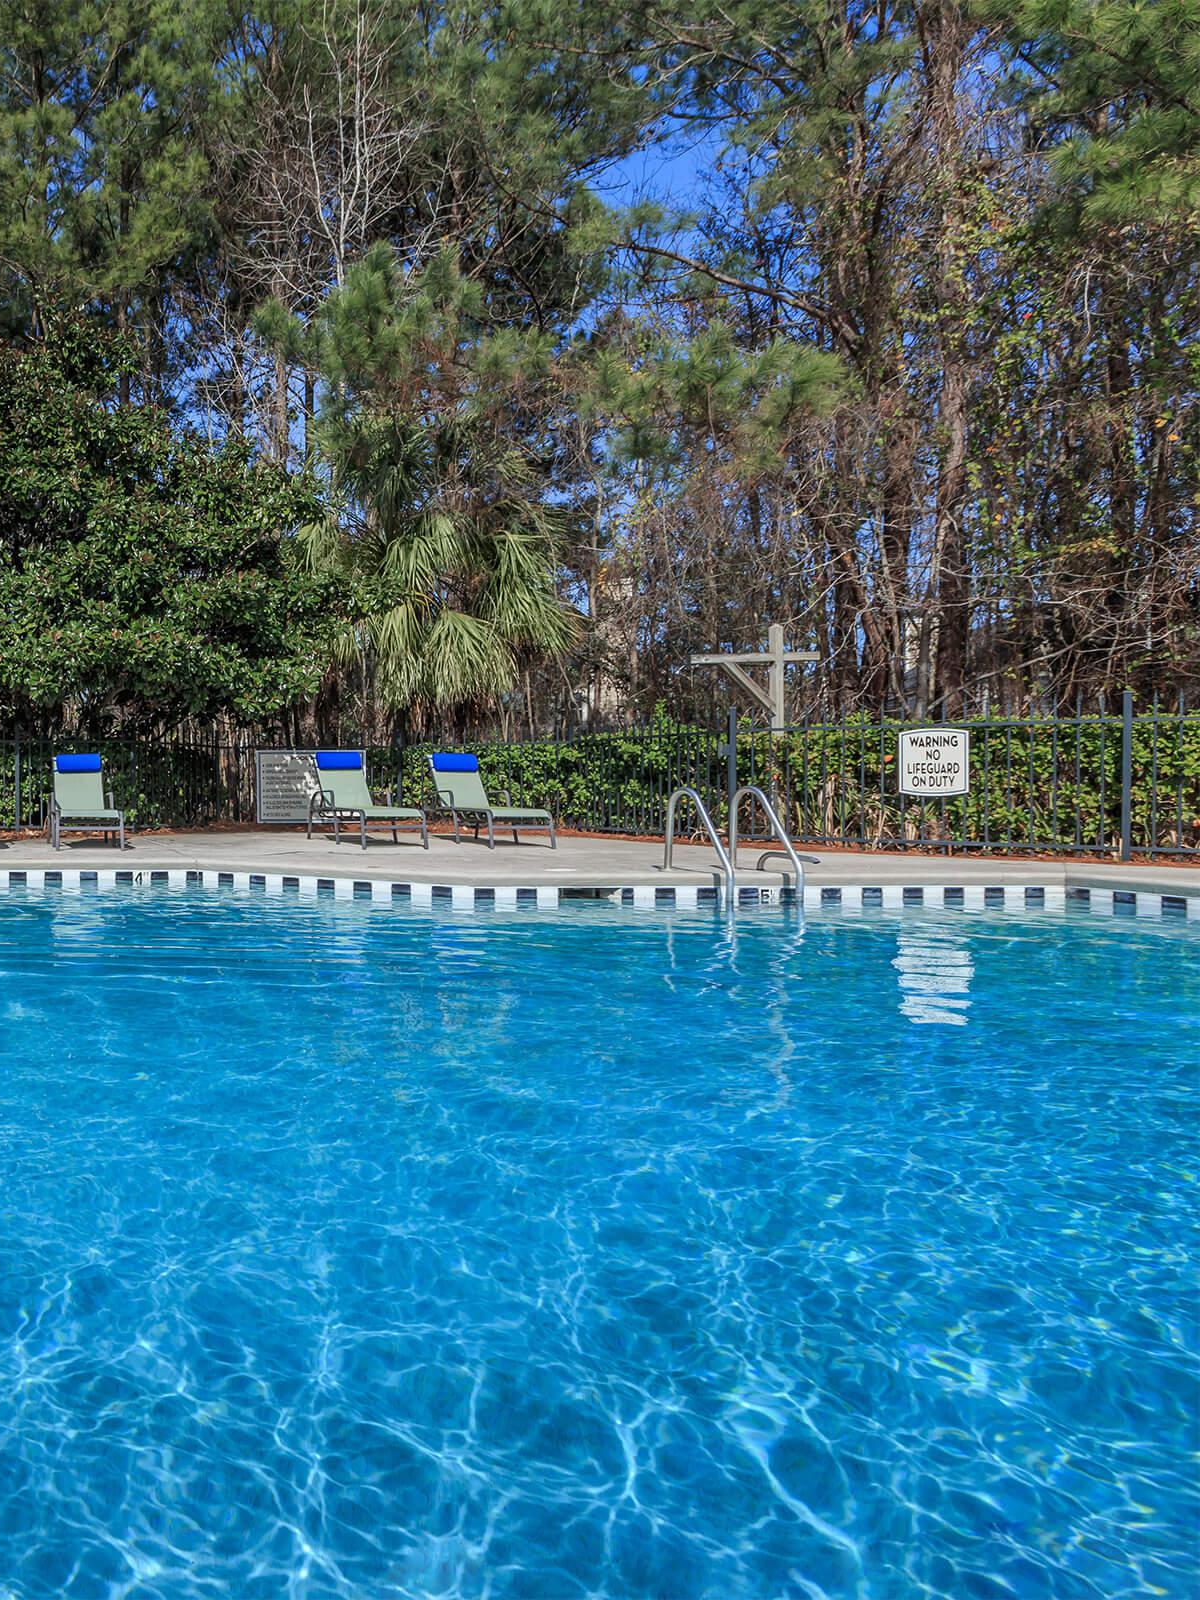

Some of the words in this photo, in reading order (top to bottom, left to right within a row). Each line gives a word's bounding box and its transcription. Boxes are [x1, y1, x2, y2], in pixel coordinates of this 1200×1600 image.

[909, 736, 959, 747] WARNING
[926, 749, 941, 760] NO
[907, 763, 960, 774] LIFEGUARD
[912, 776, 926, 787] ON
[928, 776, 955, 787] DUTY
